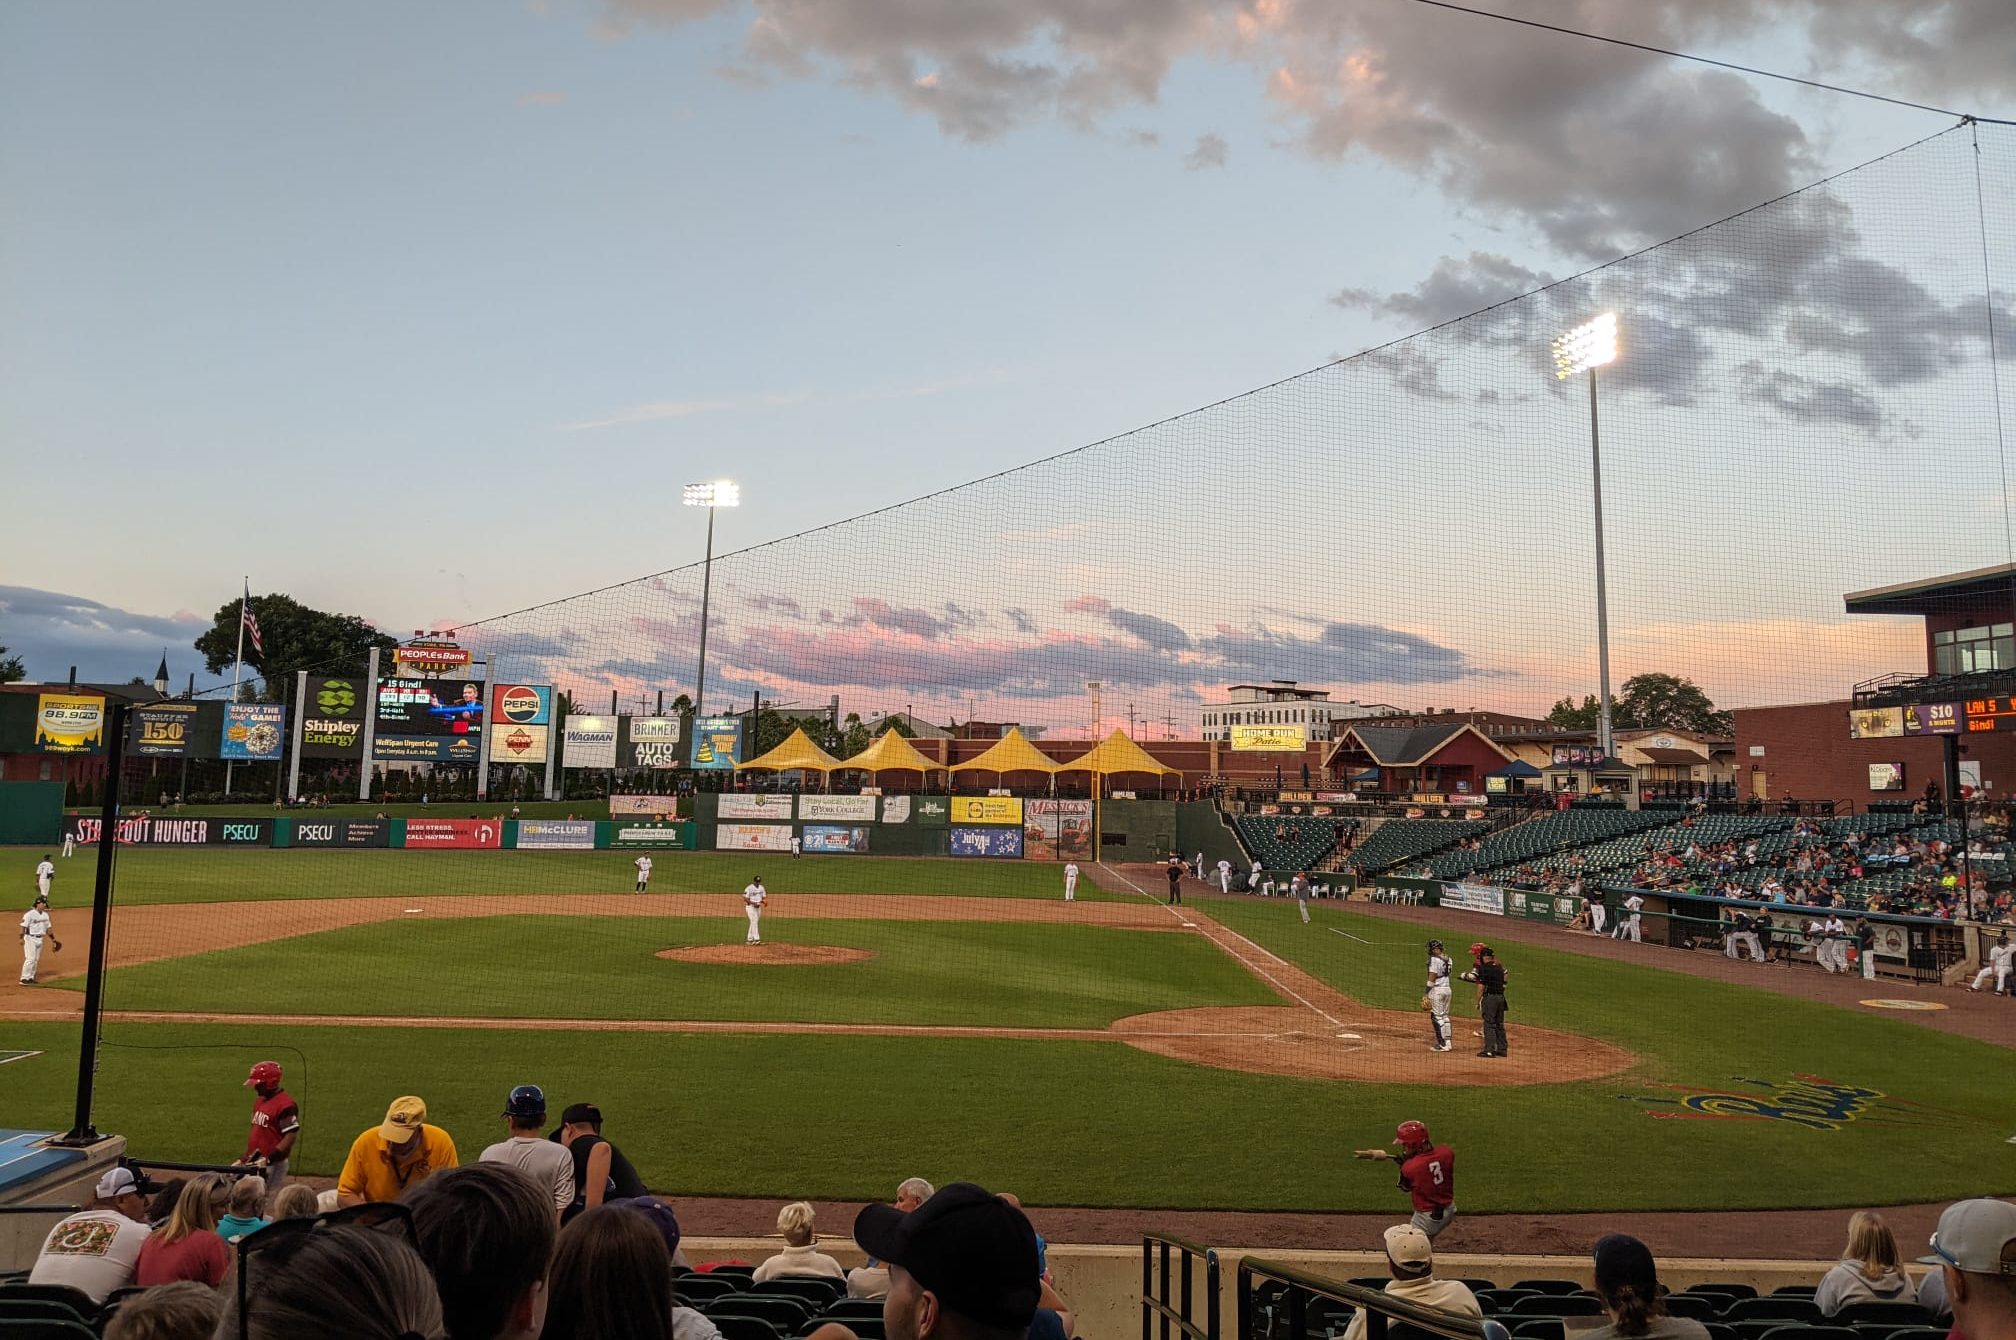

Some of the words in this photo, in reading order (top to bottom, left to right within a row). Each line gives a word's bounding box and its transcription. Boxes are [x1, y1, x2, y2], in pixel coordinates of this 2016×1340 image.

[420, 662, 446, 670] PARK
[388, 680, 398, 688] 15
[504, 700, 538, 708] PEPSI
[1988, 700, 1996, 712] 5
[1930, 704, 1953, 719] $10
[250, 714, 281, 722] GAME!
[142, 722, 184, 740] 150
[304, 720, 360, 735] Shipley
[634, 723, 677, 736] BRIMMER
[1242, 729, 1272, 737] HOME
[1273, 729, 1295, 738] RUN
[304, 732, 356, 747] Energy
[567, 731, 614, 742] WAGMAN
[1252, 737, 1281, 745] Patio
[404, 740, 424, 748] Urgent
[636, 743, 674, 754] AUTO
[715, 742, 734, 753] ZONE
[636, 754, 672, 766] TAGS
[154, 820, 208, 843] HUNGER
[223, 824, 259, 840] PSECU
[298, 824, 333, 841] PSECU
[814, 834, 824, 845] 21
[252, 1110, 270, 1128] ANC
[1428, 1161, 1444, 1185] 3
